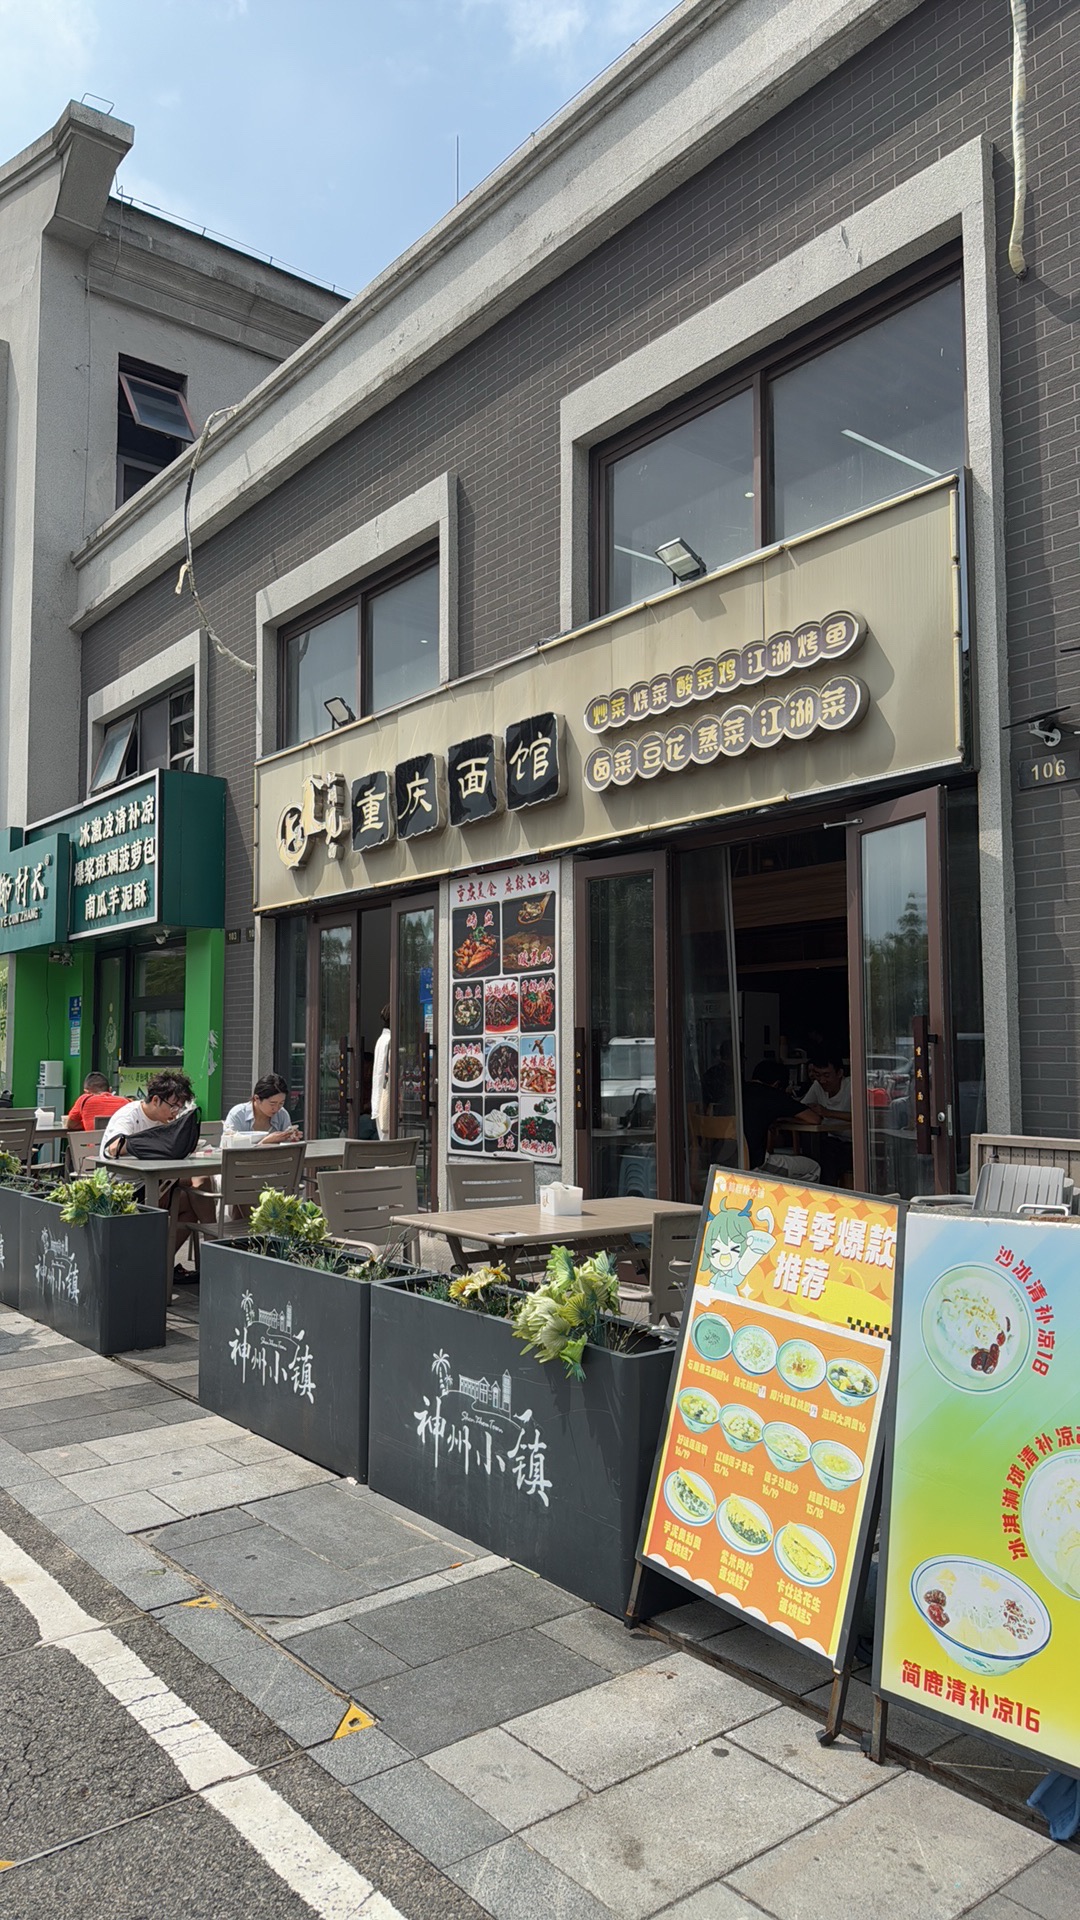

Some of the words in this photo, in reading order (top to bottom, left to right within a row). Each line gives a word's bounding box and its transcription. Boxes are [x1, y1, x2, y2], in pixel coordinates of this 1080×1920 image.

[356, 731, 552, 834] 重庆面馆
[1031, 759, 1066, 780] 106
[84, 878, 148, 921] 南瓜芋泥酥
[782, 1204, 898, 1270] 春季爆款
[772, 1250, 831, 1301] 推荐
[228, 1327, 317, 1405] 神州小镇
[413, 1394, 553, 1507] 神州小镇
[900, 1658, 1042, 1734] 简鹿清补凉16
